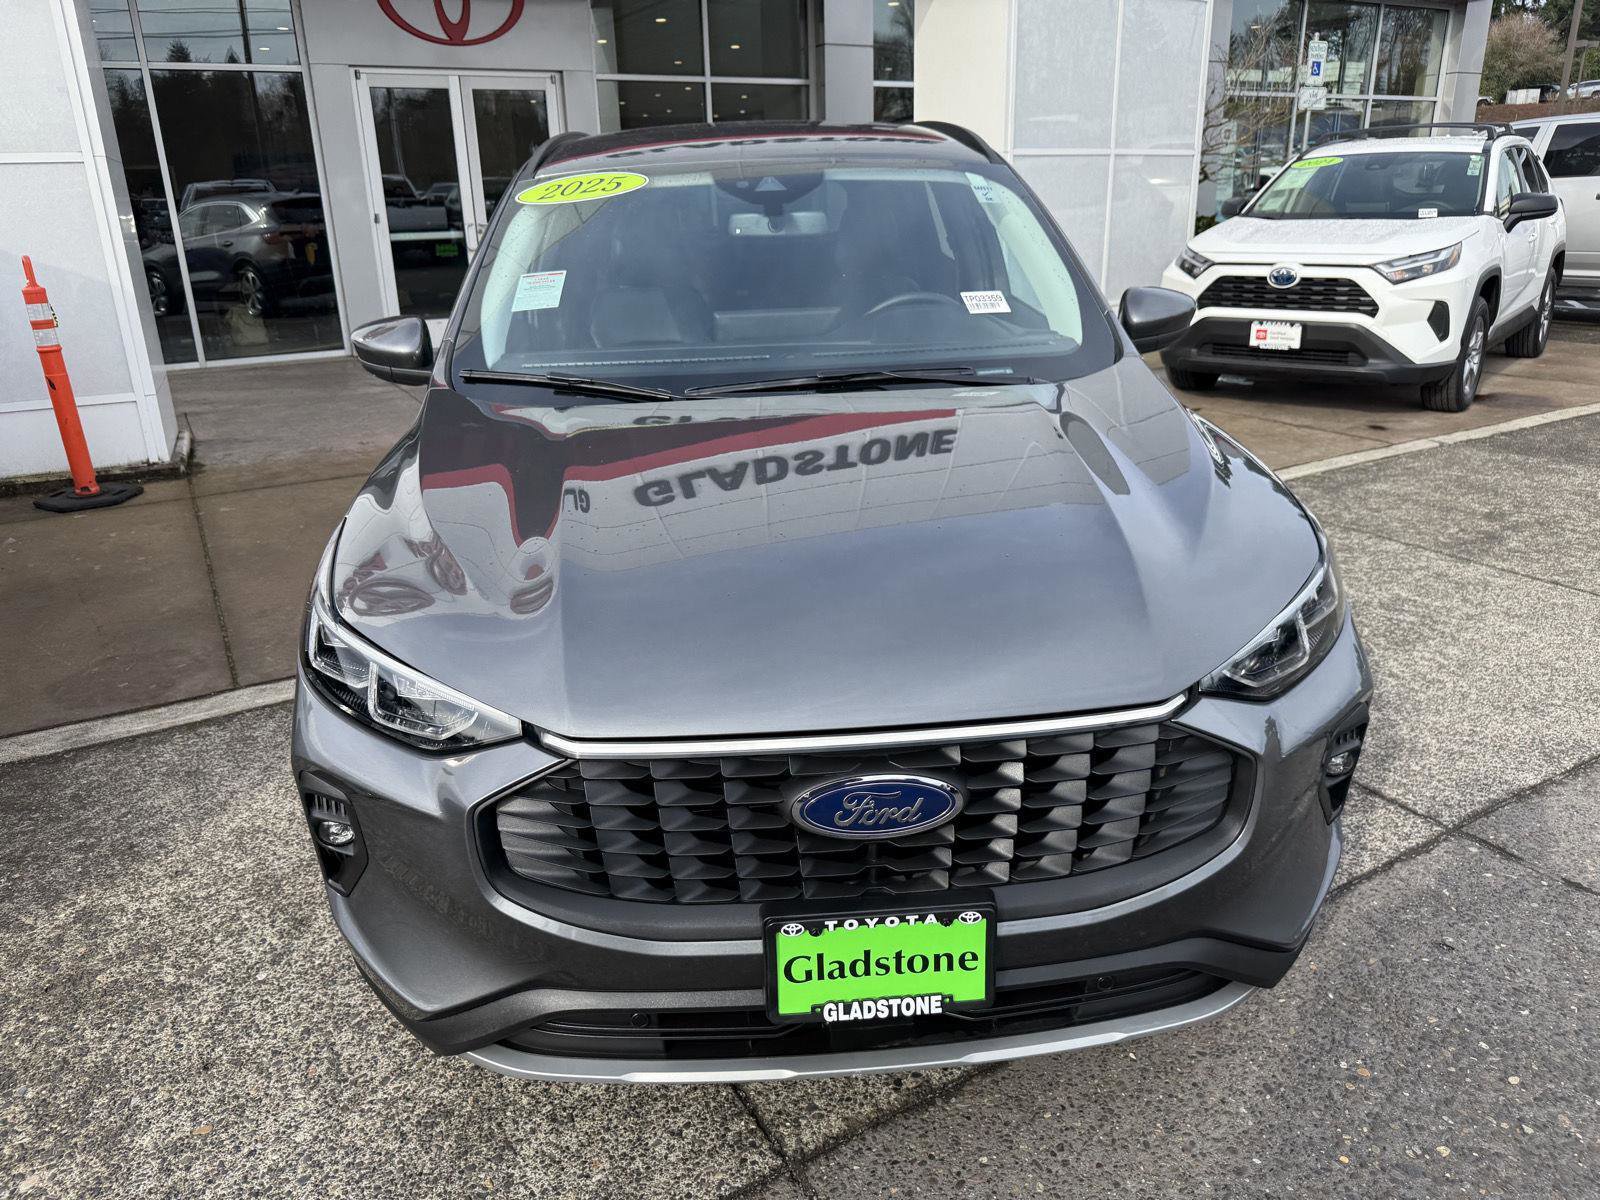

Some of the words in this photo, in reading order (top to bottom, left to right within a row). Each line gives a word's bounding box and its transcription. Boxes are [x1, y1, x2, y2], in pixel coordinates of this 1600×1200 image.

[537, 176, 627, 200] 2025
[834, 791, 924, 826] Ford
[825, 914, 938, 931] TOYOTA
[783, 949, 979, 984] Gladstone
[823, 995, 943, 1022] GLADSTONE
